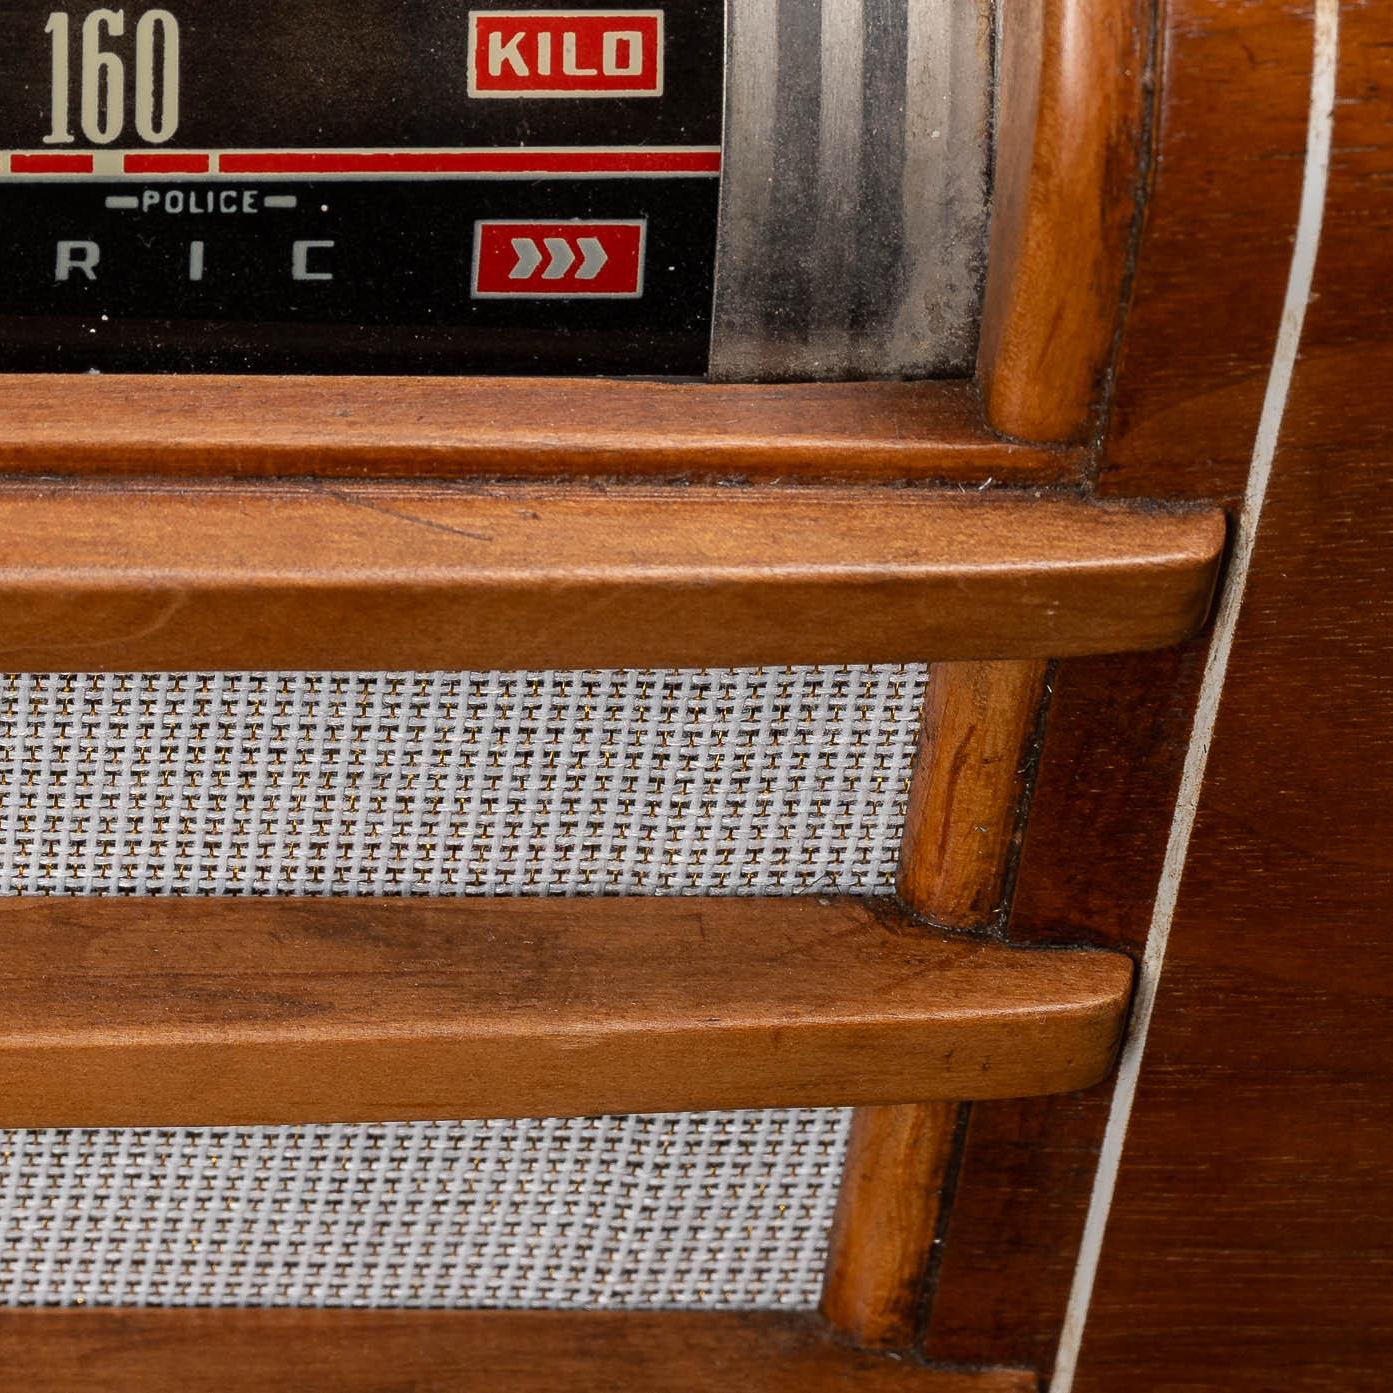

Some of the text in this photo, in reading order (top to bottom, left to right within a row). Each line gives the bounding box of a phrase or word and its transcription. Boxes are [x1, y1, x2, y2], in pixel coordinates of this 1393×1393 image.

[42, 8, 181, 145] 160
[486, 30, 644, 77] KILO
[141, 189, 259, 214] POLICE
